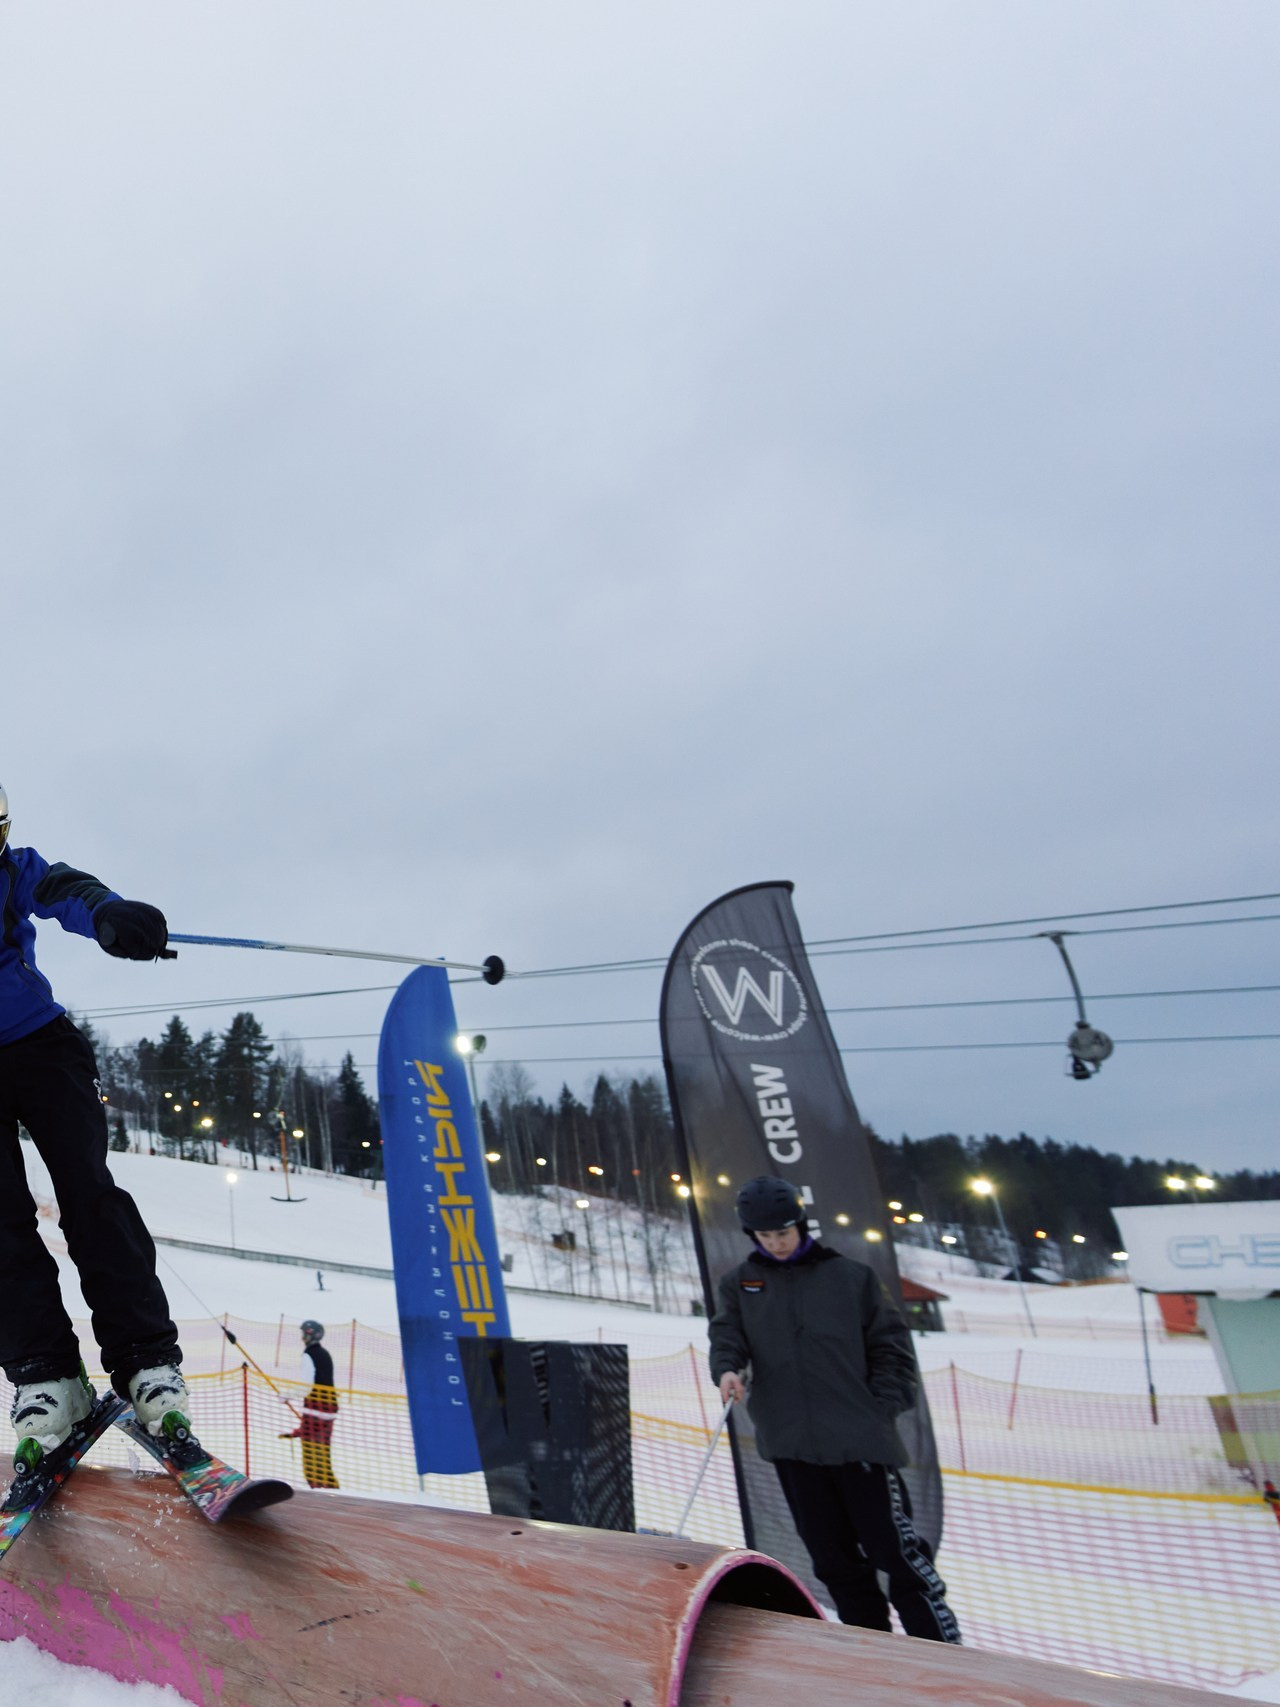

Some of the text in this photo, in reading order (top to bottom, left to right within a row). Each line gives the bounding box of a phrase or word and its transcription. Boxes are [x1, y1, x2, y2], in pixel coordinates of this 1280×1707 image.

[404, 1057, 464, 1407] ГОРНОЛЫЖНЫЙ КУРОРТ
[414, 1058, 499, 1338] НЕЖНЫЙ
[750, 1063, 802, 1165] CREW
